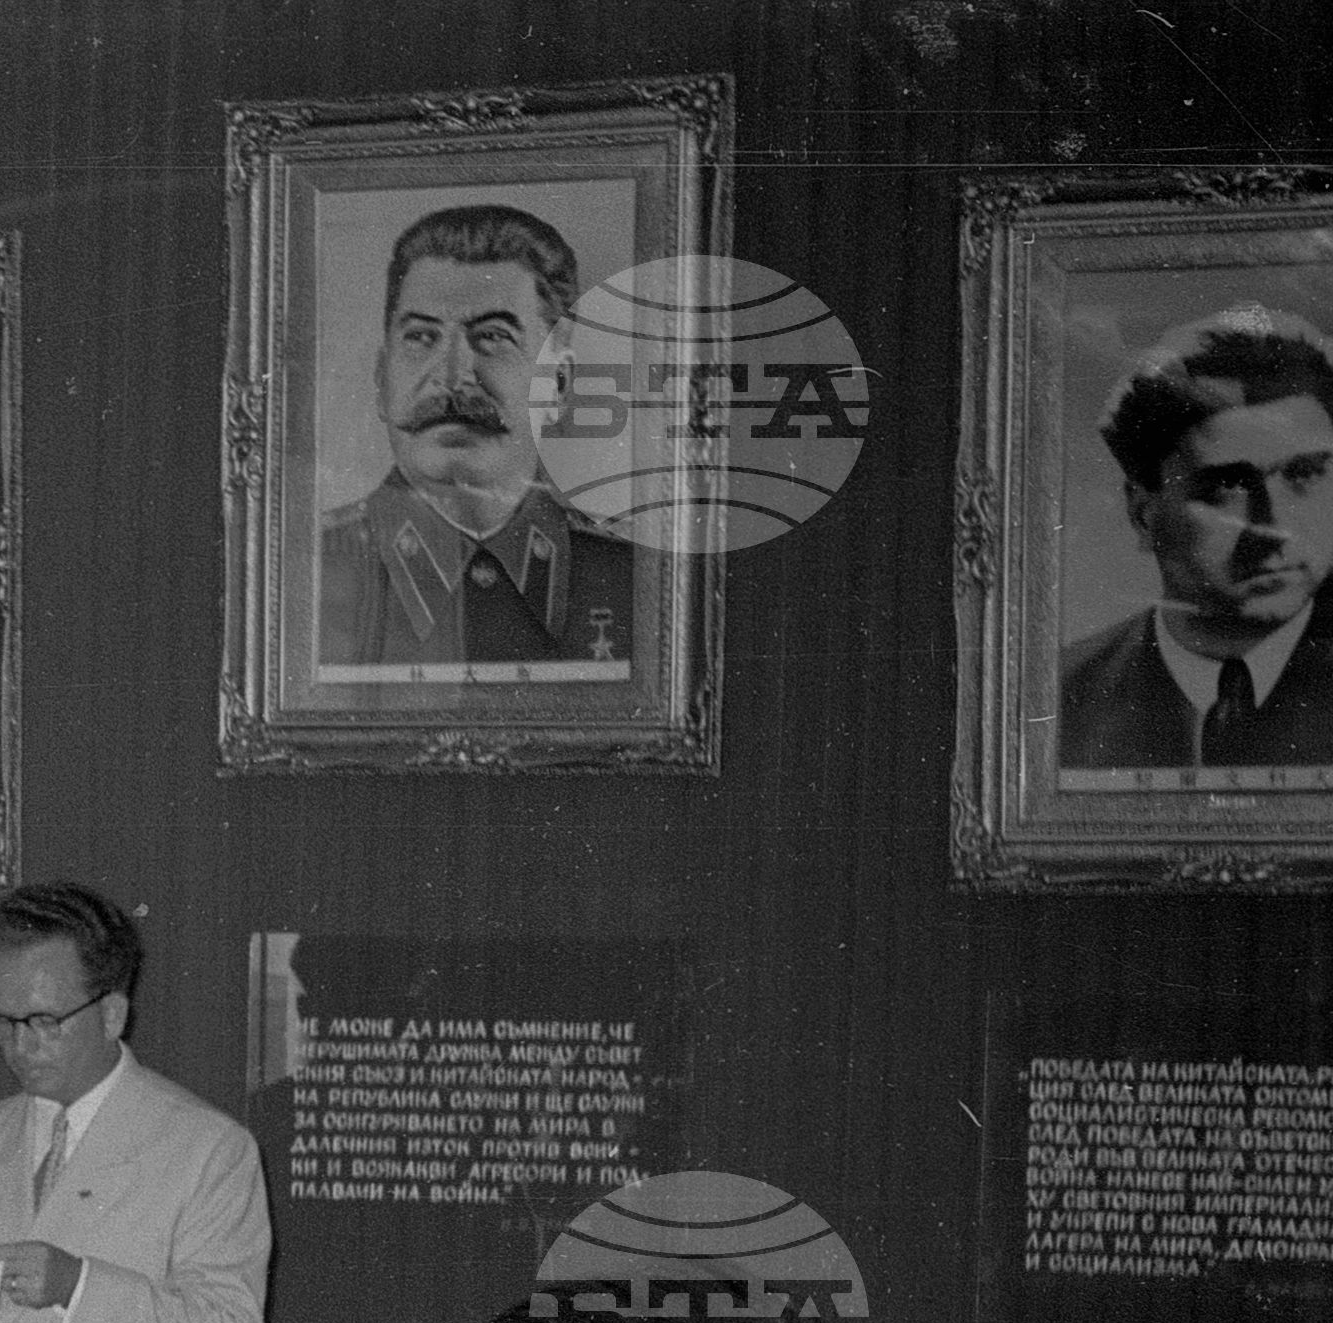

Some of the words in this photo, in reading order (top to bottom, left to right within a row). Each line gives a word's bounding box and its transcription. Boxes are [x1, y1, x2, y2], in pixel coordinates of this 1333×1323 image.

[328, 1017, 394, 1038] МОЖЕ
[400, 1019, 433, 1041] ДА
[439, 1019, 487, 1040] ИМА
[609, 1021, 635, 1041] ЧЕ
[423, 1043, 503, 1063] ДРУЖБА
[509, 1043, 581, 1066] МЕЖДУ
[352, 1065, 406, 1084] СЪЮЗ
[410, 1066, 425, 1084] И
[430, 1062, 552, 1087] КИТАЙСКАТА
[1141, 1061, 1170, 1081] НА
[294, 1088, 319, 1106] НА
[328, 1088, 441, 1109] РЕПУБЛИКА
[450, 1090, 520, 1110] СЛУЖИ
[526, 1092, 540, 1111] И
[544, 1092, 574, 1114] ЩЕ
[577, 1093, 645, 1113] СЛУЖИ
[1029, 1081, 1075, 1102] ЦИЯ
[1081, 1082, 1135, 1103] СЛЕД
[1138, 1083, 1247, 1105] ВЕЛИКАТА
[293, 1111, 317, 1130] ЗА
[322, 1112, 484, 1134] ОСИГУРЯВАНЕТО
[495, 1116, 522, 1134] НА
[527, 1117, 591, 1136] МИРА
[601, 1118, 616, 1138] В
[1029, 1102, 1246, 1127] СОЦИАЛИСТИЧЕСКА
[289, 1135, 397, 1154] ДАЛЕЧНИЯ
[407, 1136, 470, 1157] ИЗТОК
[482, 1139, 561, 1159] ПРОТИВ
[1028, 1123, 1082, 1145] СЛЕД
[1087, 1124, 1196, 1148] ПОБЕДАТА
[1205, 1129, 1234, 1148] НА
[1027, 1145, 1090, 1168] РОДИ
[1095, 1148, 1137, 1168] ВЪВ
[1141, 1149, 1246, 1170] ВЕЛИКАТА
[290, 1158, 318, 1177] КИ
[326, 1159, 342, 1177] И
[351, 1159, 457, 1180] ВСЯКАКВИ
[470, 1163, 567, 1184] АГРЕСОРИ
[576, 1165, 593, 1184] И
[1025, 1165, 1097, 1187] ВОЙНА
[1106, 1170, 1186, 1192] НАНЕСЕ
[1191, 1170, 1313, 1196] НАЙ-СИЛЕН
[394, 1184, 420, 1201] НА
[1026, 1189, 1056, 1209] ХУ
[1062, 1190, 1186, 1213] СВЕТОВНИЯ
[1026, 1210, 1043, 1230] И
[1049, 1210, 1136, 1233] УКРЕПИ
[1141, 1213, 1155, 1234] С
[1162, 1214, 1218, 1236] НОВА
[1025, 1231, 1105, 1252] ЛАГЕРА
[1114, 1234, 1142, 1254] НА
[1223, 1239, 1333, 1262] ДЕМОКРА
[1025, 1252, 1041, 1272] И
